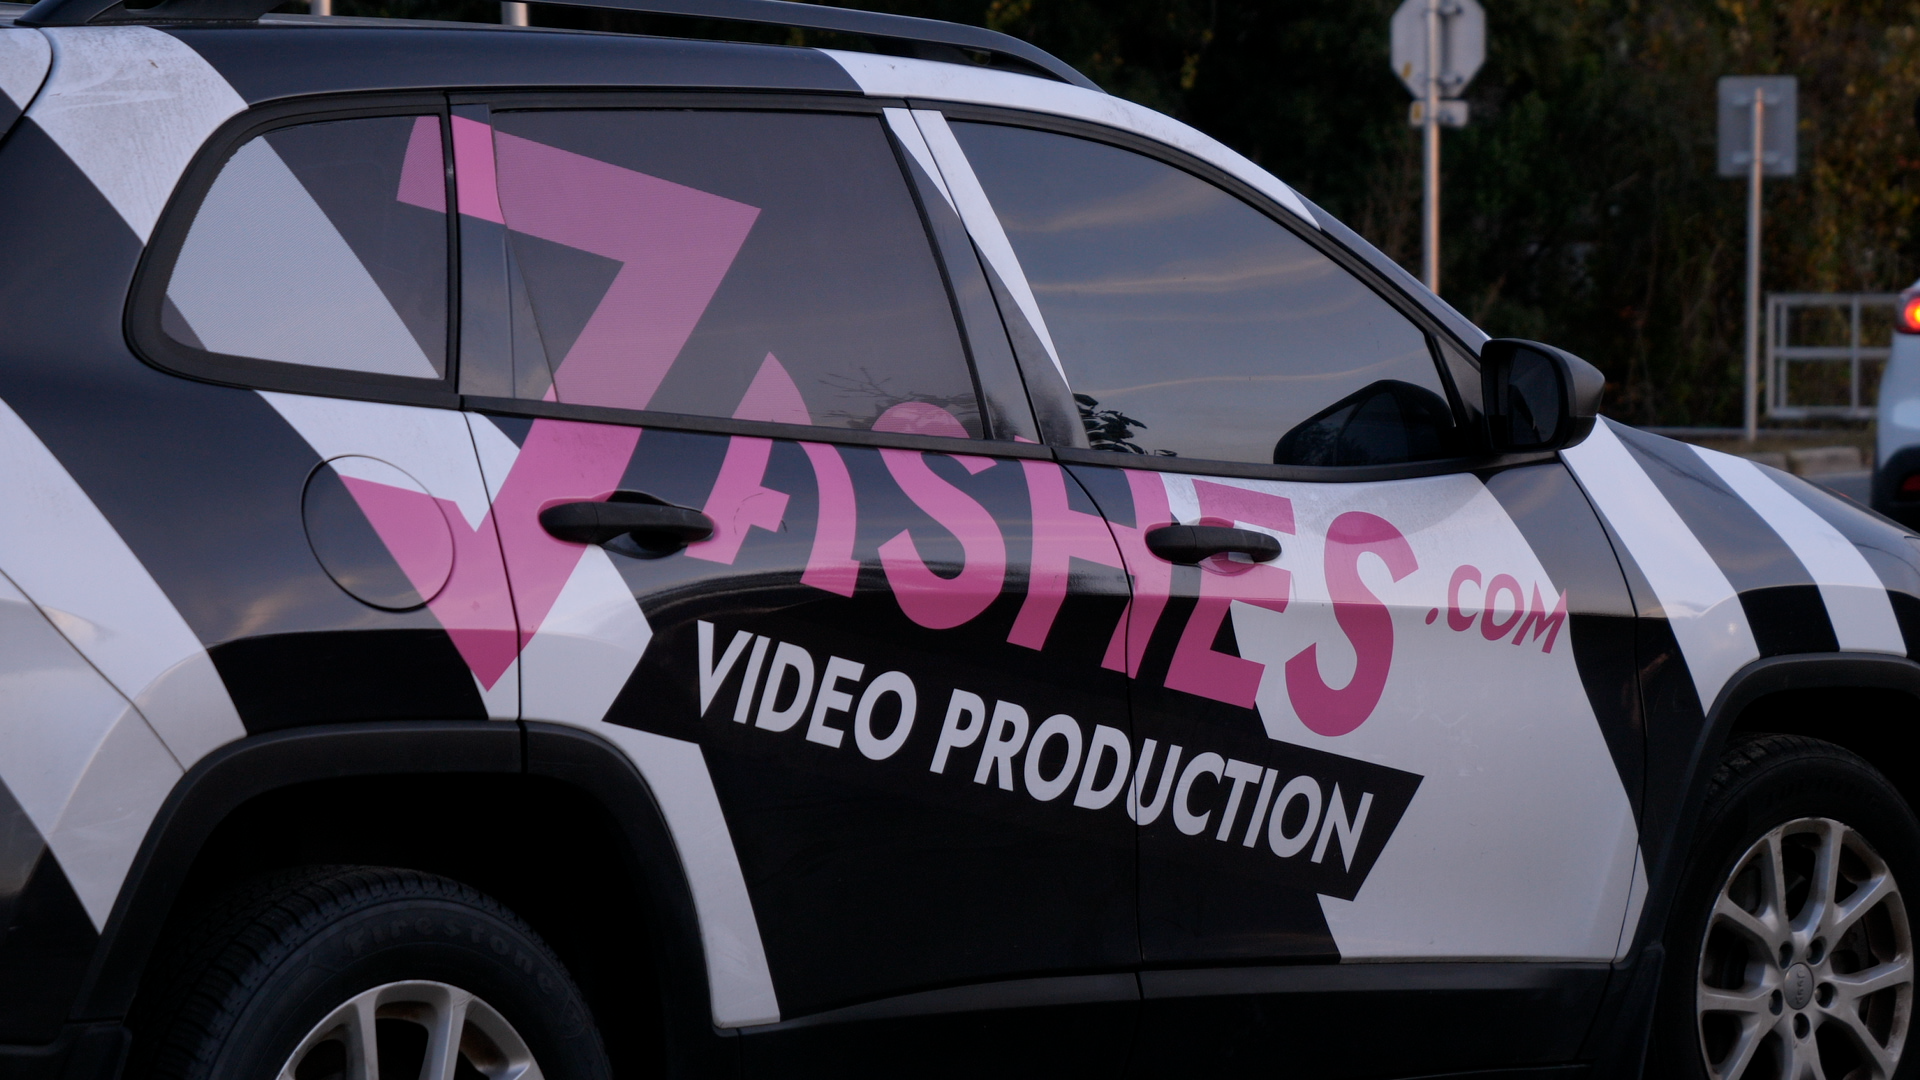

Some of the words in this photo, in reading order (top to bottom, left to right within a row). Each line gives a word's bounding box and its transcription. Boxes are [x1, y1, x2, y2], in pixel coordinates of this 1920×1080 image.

[697, 619, 917, 761] VIDEO
[929, 688, 1374, 873] PRODUCTION
[346, 917, 556, 996] Firestone
